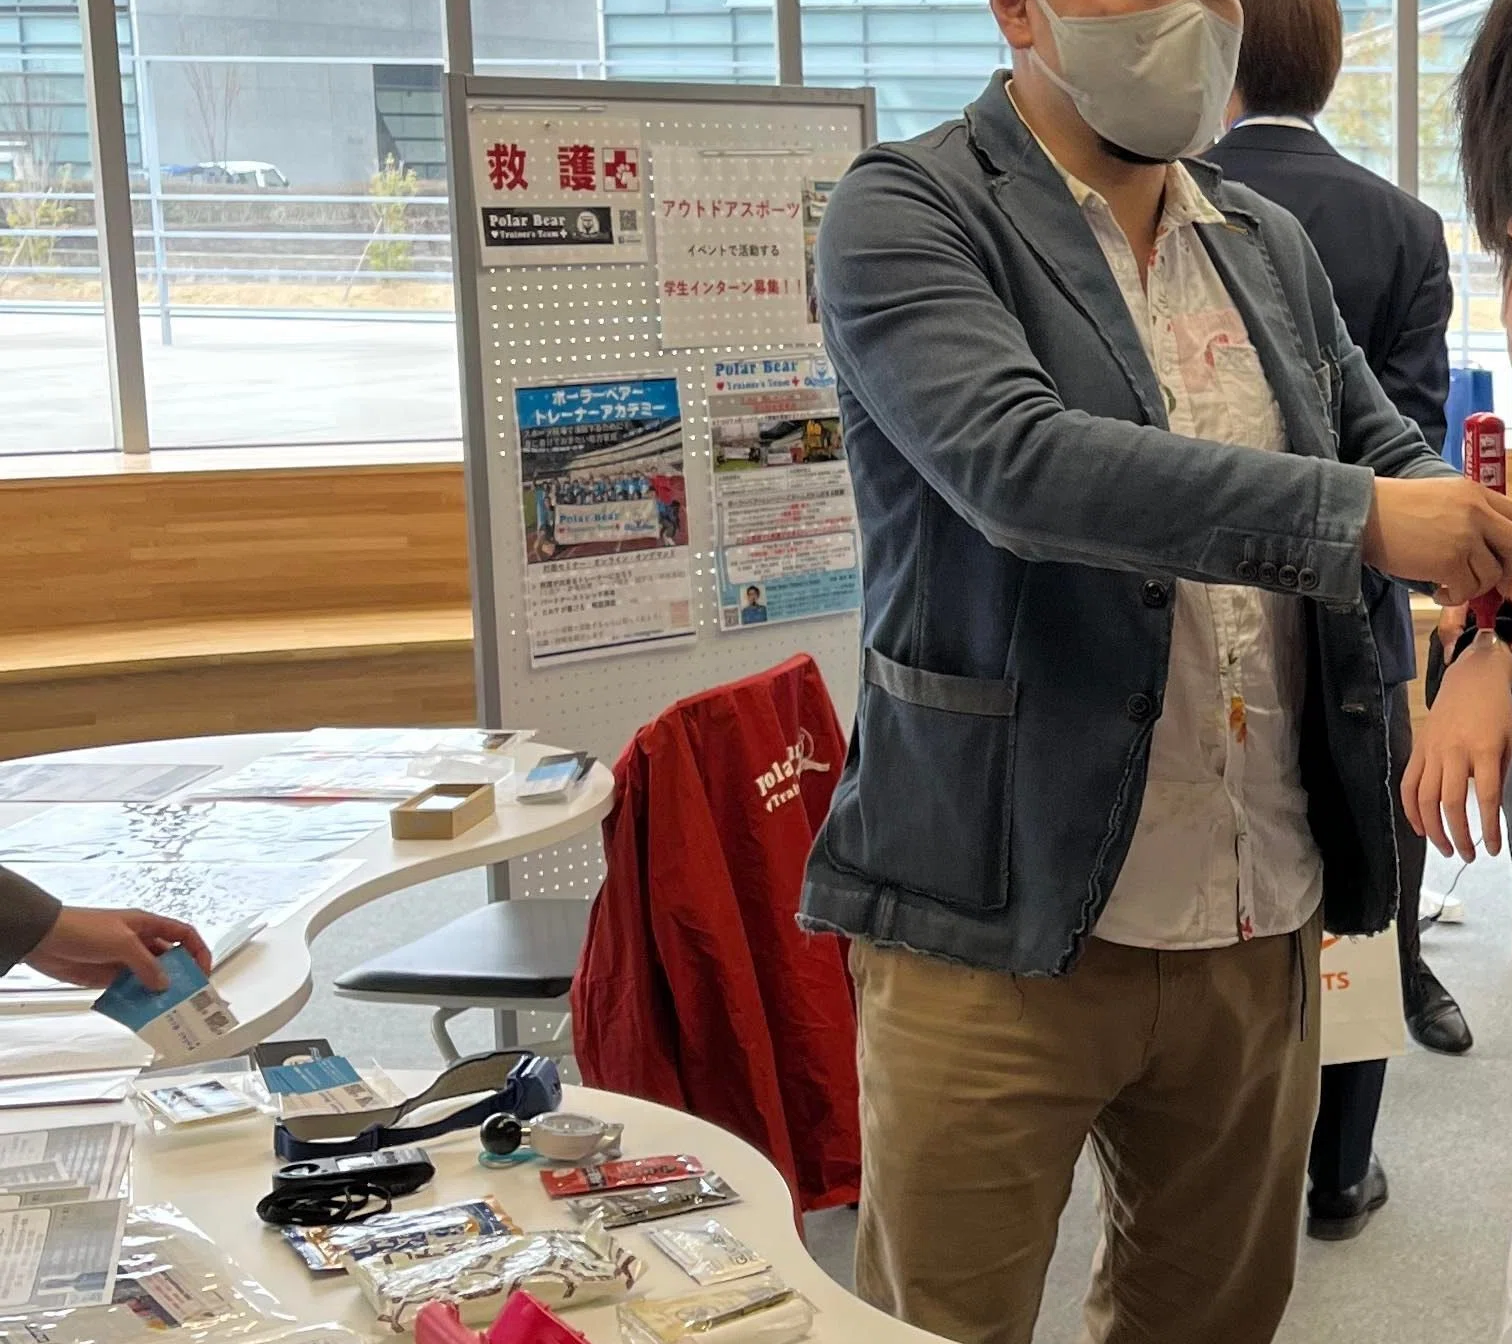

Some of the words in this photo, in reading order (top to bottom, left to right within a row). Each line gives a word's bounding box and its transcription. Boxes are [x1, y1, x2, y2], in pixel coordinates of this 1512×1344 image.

[662, 199, 800, 219] アウトドアスポーツ
[489, 214, 529, 227] Polar
[533, 214, 566, 227] Bear
[688, 244, 780, 257] イベントで活動する
[715, 362, 757, 376] Polar
[763, 359, 799, 373] Bear
[536, 401, 666, 426] トレーナーアカデミー
